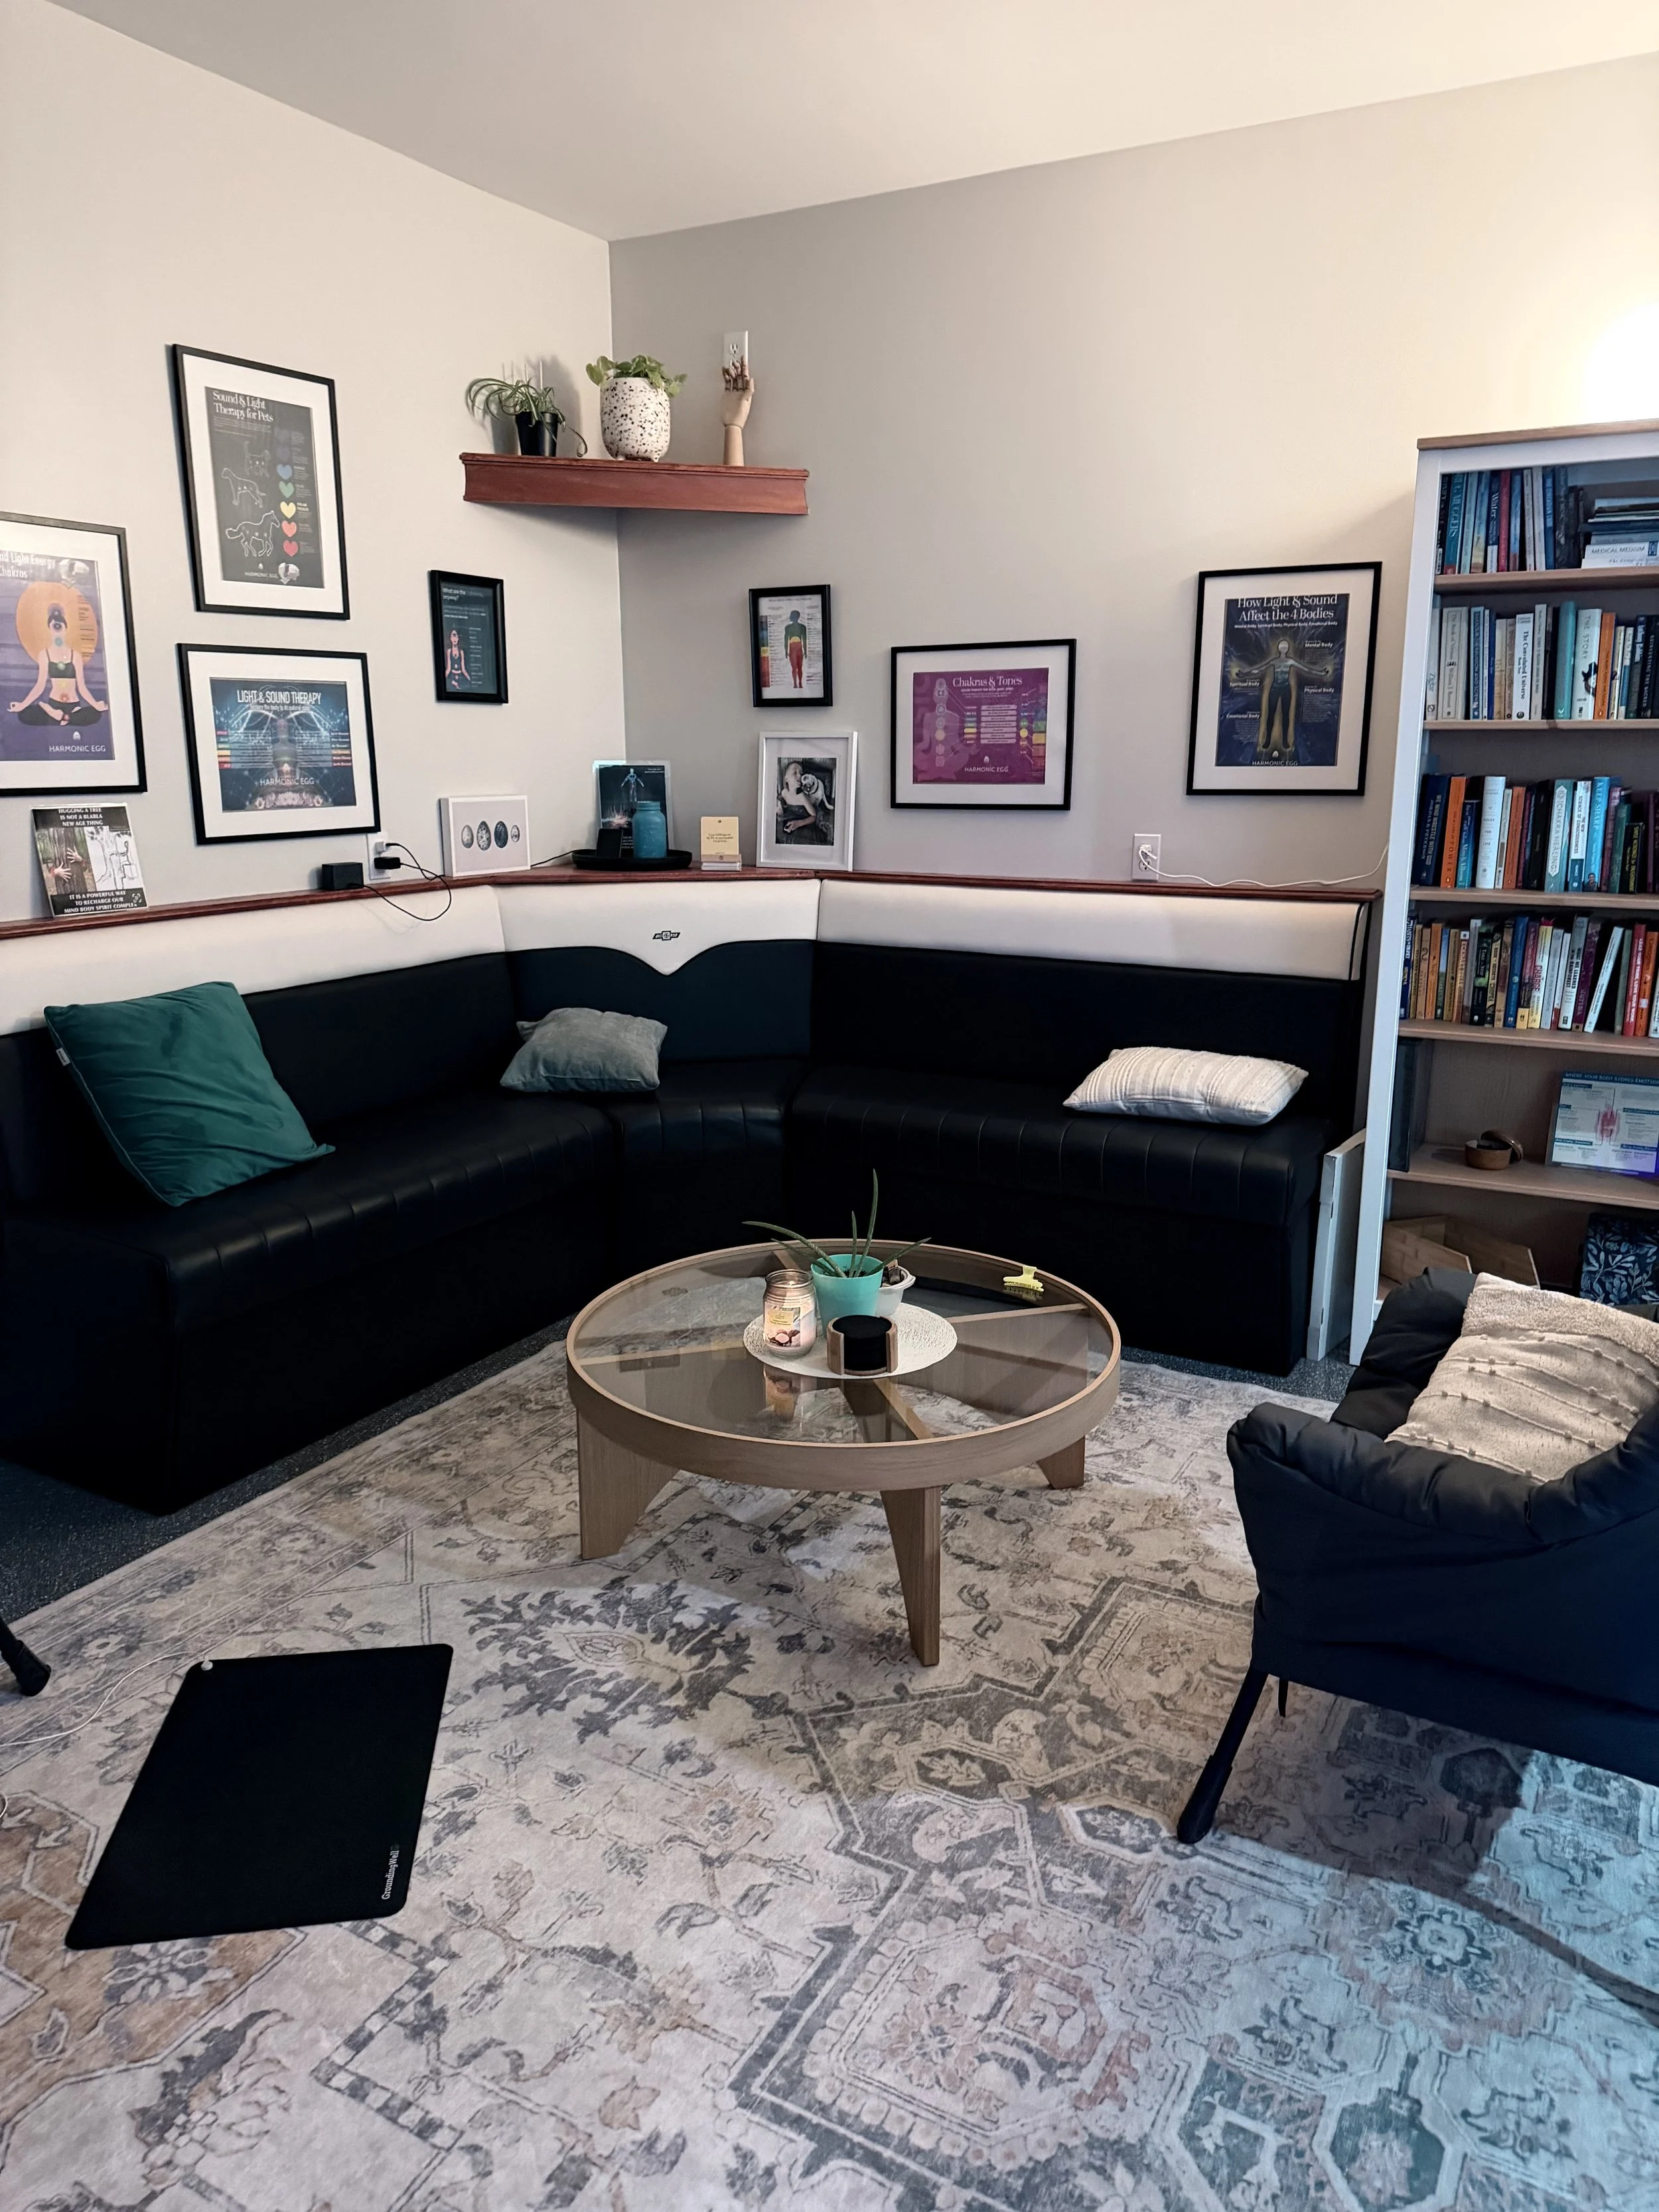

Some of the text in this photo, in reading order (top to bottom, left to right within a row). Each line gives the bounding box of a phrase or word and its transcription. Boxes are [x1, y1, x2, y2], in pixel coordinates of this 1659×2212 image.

[213, 390, 265, 409] Sound & Light
[214, 402, 273, 422] Therapy for Pets
[1490, 492, 1499, 518] Water
[11, 552, 29, 565] Light
[31, 554, 56, 569] Energy
[1238, 593, 1338, 609] How Light & Sound
[1239, 607, 1334, 621] Affect the 4 Bodies
[952, 676, 1023, 688] Chakras & Tones
[237, 690, 321, 705] LIGHT & SOUND THERAPY
[1435, 794, 1443, 803] WE
[1593, 781, 1603, 830] KEEP SHARP
[1429, 816, 1439, 840] WRESTLE
[1550, 802, 1563, 870] CHAKRA HEALING
[1421, 829, 1430, 859] PETERSON
[1427, 841, 1435, 854] WITH
[1458, 861, 1467, 881] Albom
[1459, 940, 1467, 969] ECKHART
[1532, 965, 1542, 992] CHARGE
[381, 1850, 399, 1899] GroundingWell
